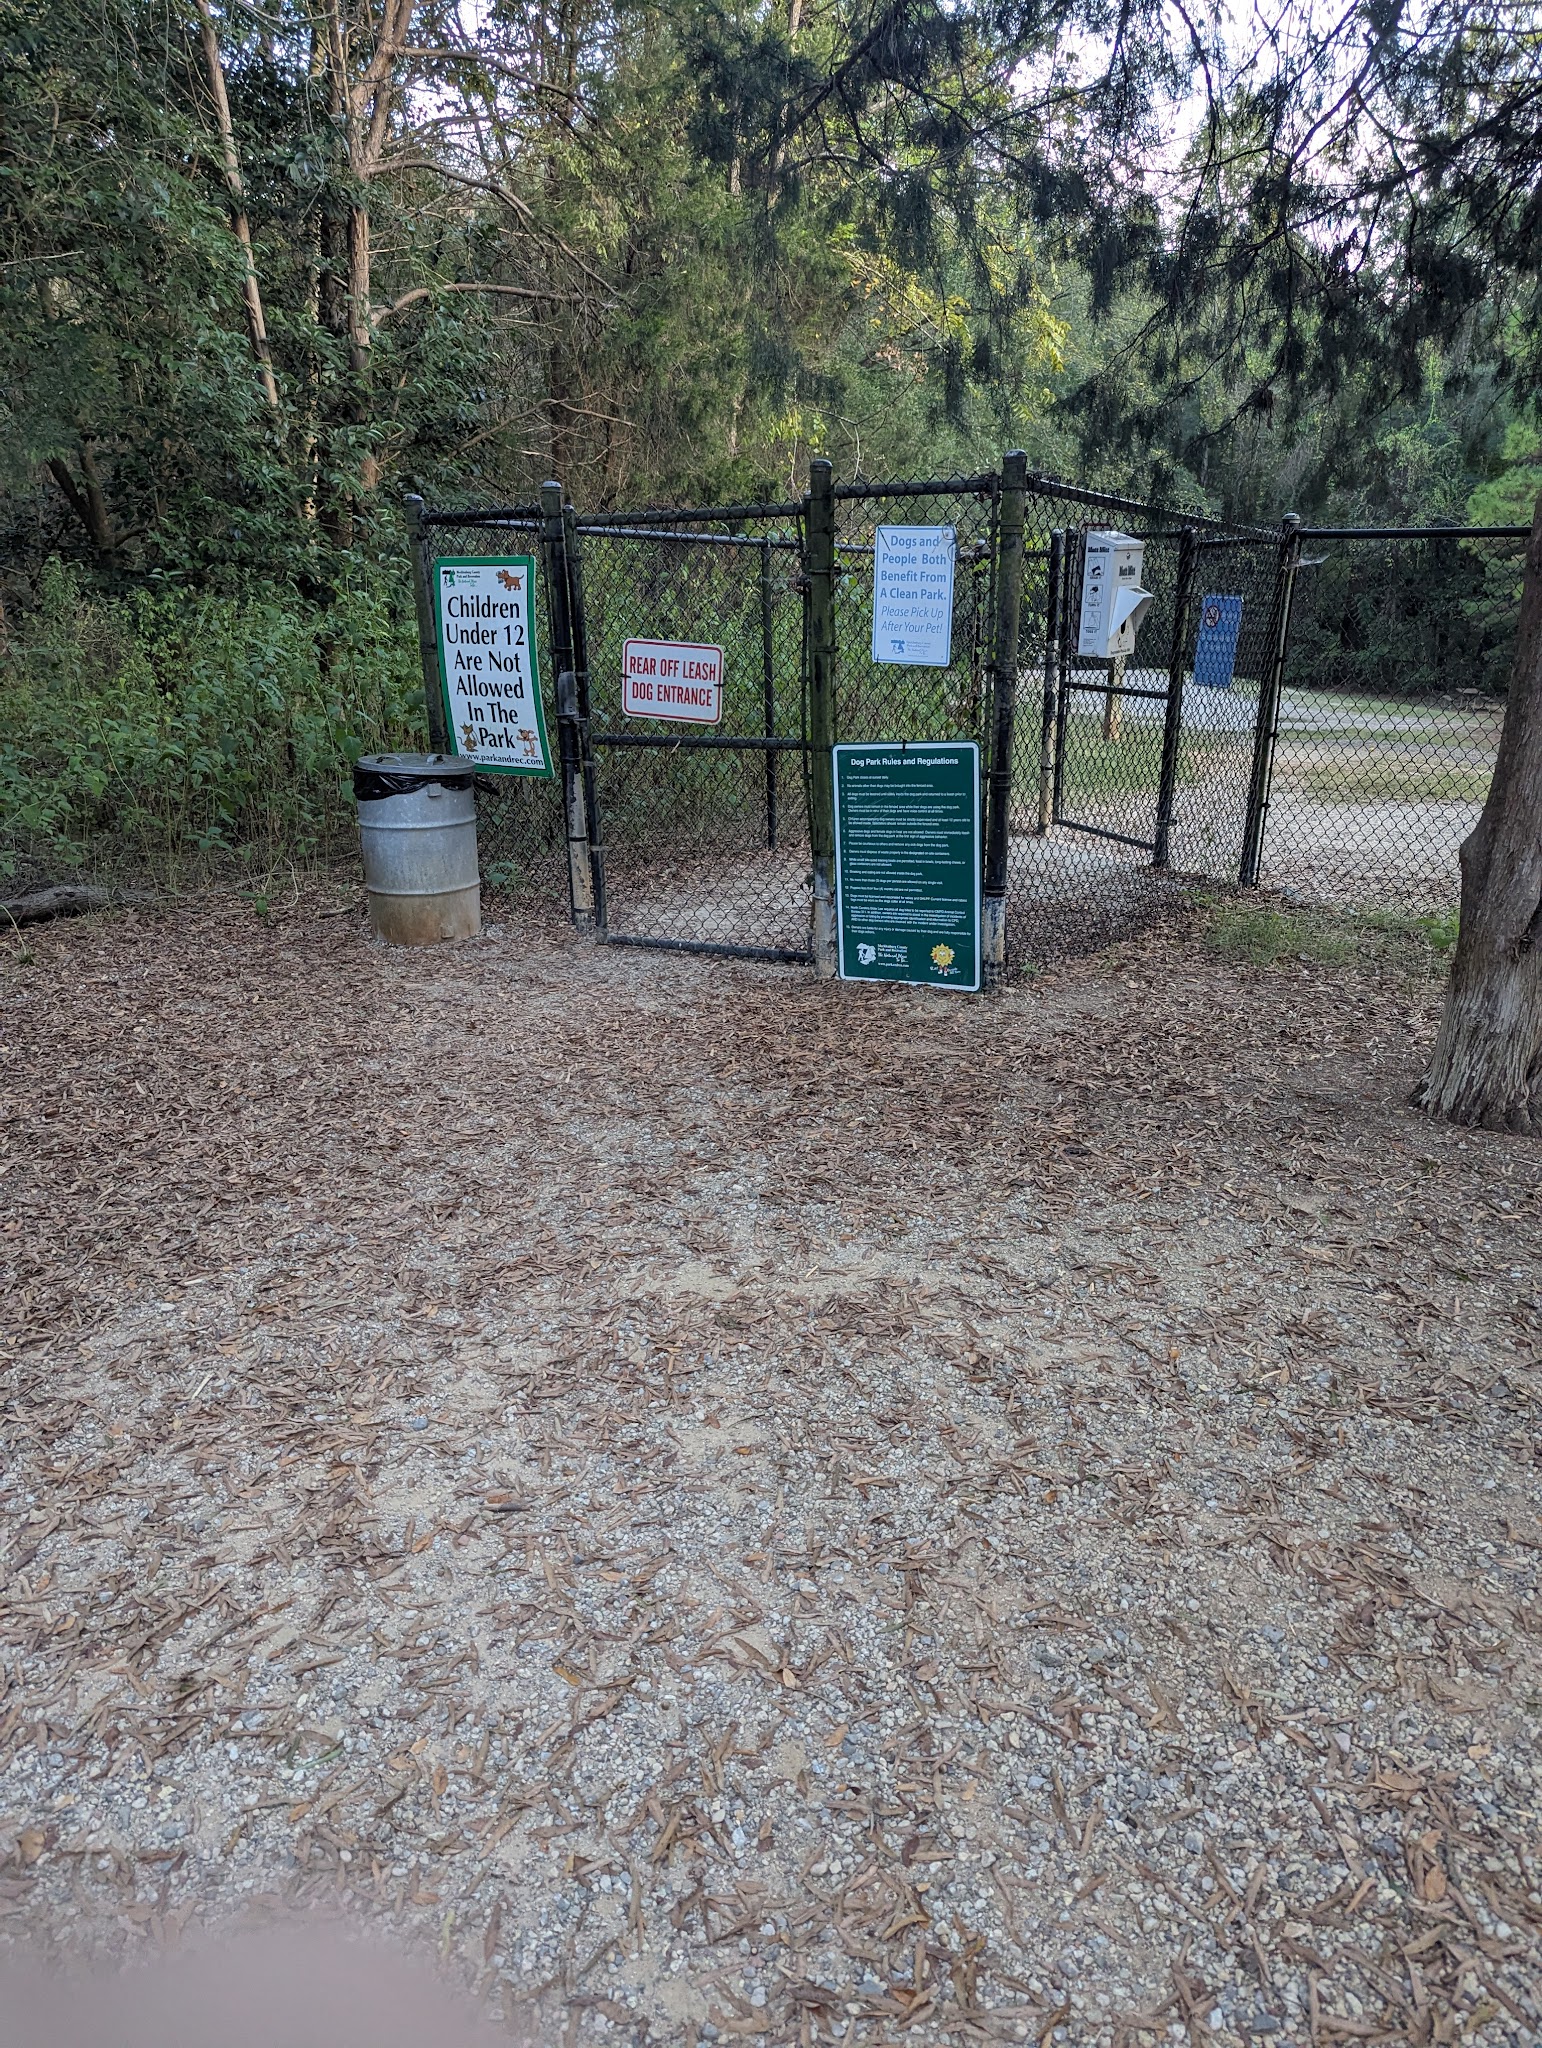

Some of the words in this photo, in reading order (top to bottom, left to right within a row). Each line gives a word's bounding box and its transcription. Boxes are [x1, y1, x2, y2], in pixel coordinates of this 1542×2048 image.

[891, 536, 916, 549] Dogs
[920, 536, 939, 546] and
[883, 553, 917, 566] People
[922, 554, 946, 564] Both
[881, 570, 917, 581] Benefit
[920, 572, 946, 582] From
[880, 588, 887, 598] A
[890, 588, 917, 599] Clean
[921, 589, 946, 600] Park.
[448, 595, 519, 618] Children
[881, 606, 909, 616] Please
[911, 607, 928, 617] Pick
[931, 608, 943, 620] Up
[446, 622, 497, 644] Under
[504, 625, 524, 645] 12
[881, 621, 902, 631] After
[905, 622, 924, 633] Your
[926, 623, 942, 633] Pet!
[455, 650, 482, 670] Are
[489, 651, 521, 672] Not
[630, 656, 656, 675] REAR
[661, 659, 679, 677] OFF
[683, 661, 716, 681] LEASH
[457, 674, 524, 698] Allowed
[632, 682, 653, 700] DOG
[658, 684, 712, 706] ENTRANCE
[468, 702, 484, 721] In
[487, 702, 518, 724] The
[479, 728, 516, 748] Park
[460, 753, 543, 765] www.parkandrec.com
[851, 759, 864, 767] Dog
[917, 758, 958, 766] Regulations
